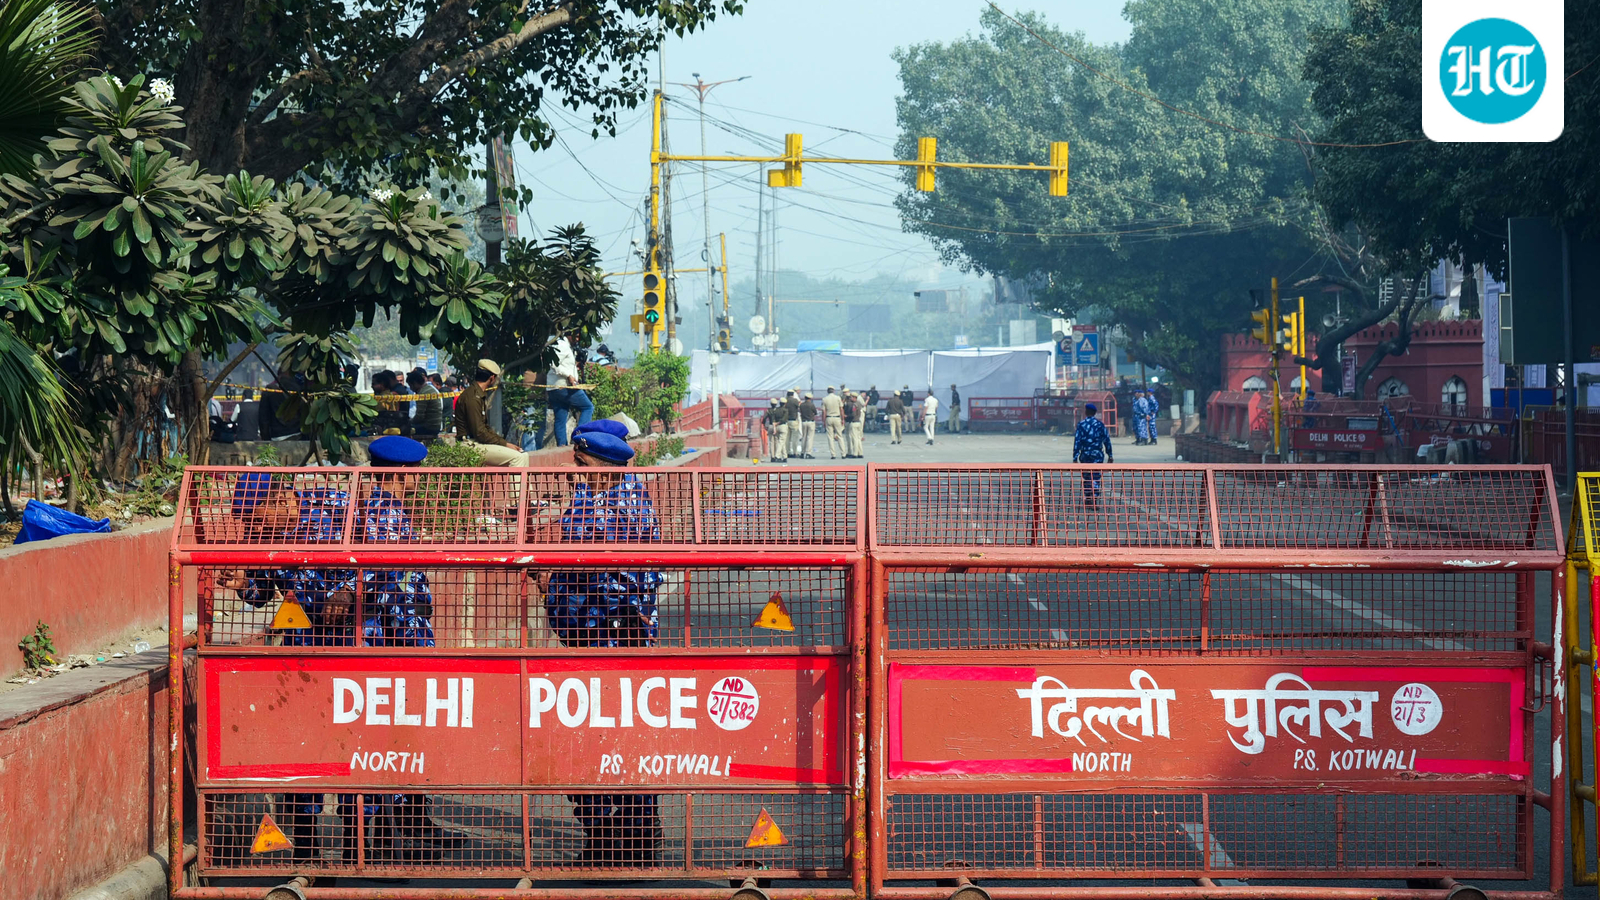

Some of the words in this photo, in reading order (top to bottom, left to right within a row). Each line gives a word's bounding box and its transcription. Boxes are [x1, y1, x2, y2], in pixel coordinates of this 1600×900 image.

[1309, 433, 1329, 442] DELHI
[1333, 433, 1357, 443] POLICE
[722, 678, 744, 692] ND
[1403, 686, 1422, 698] ND
[333, 677, 474, 728] DELHI
[529, 677, 697, 729] POLICE
[710, 694, 755, 723] 21/382
[1015, 669, 1176, 747] दिल्ली
[1210, 672, 1380, 754] पुलिस
[1394, 702, 1426, 726] 21/3
[349, 751, 425, 774] NORTH
[638, 753, 732, 777] KOTWALI
[1072, 752, 1132, 773] NORTH
[1294, 749, 1320, 771] P.S.
[1328, 749, 1417, 771] KOTWALI
